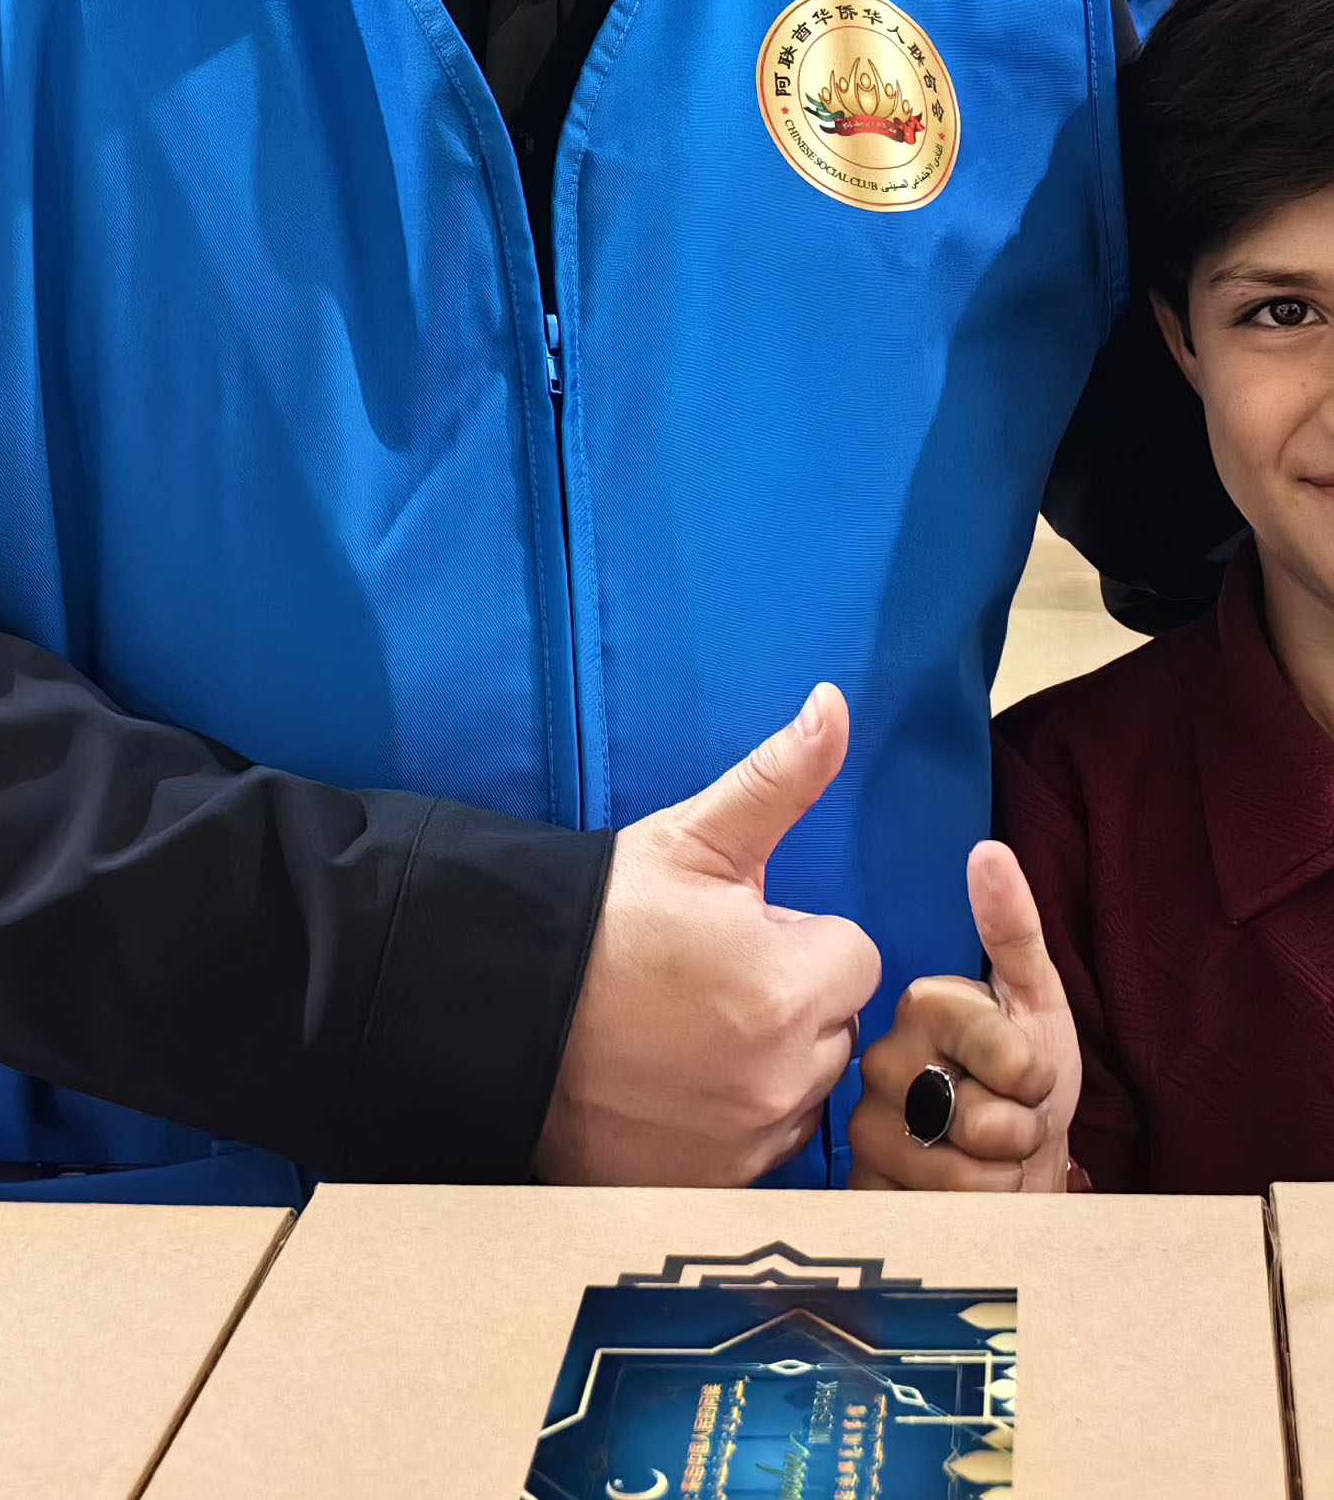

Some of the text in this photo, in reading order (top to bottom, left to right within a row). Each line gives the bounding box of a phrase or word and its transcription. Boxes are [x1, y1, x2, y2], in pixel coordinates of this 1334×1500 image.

[784, 118, 817, 162] CHINESE
[815, 156, 850, 184] SOCIAL
[850, 177, 879, 192] CLUB
